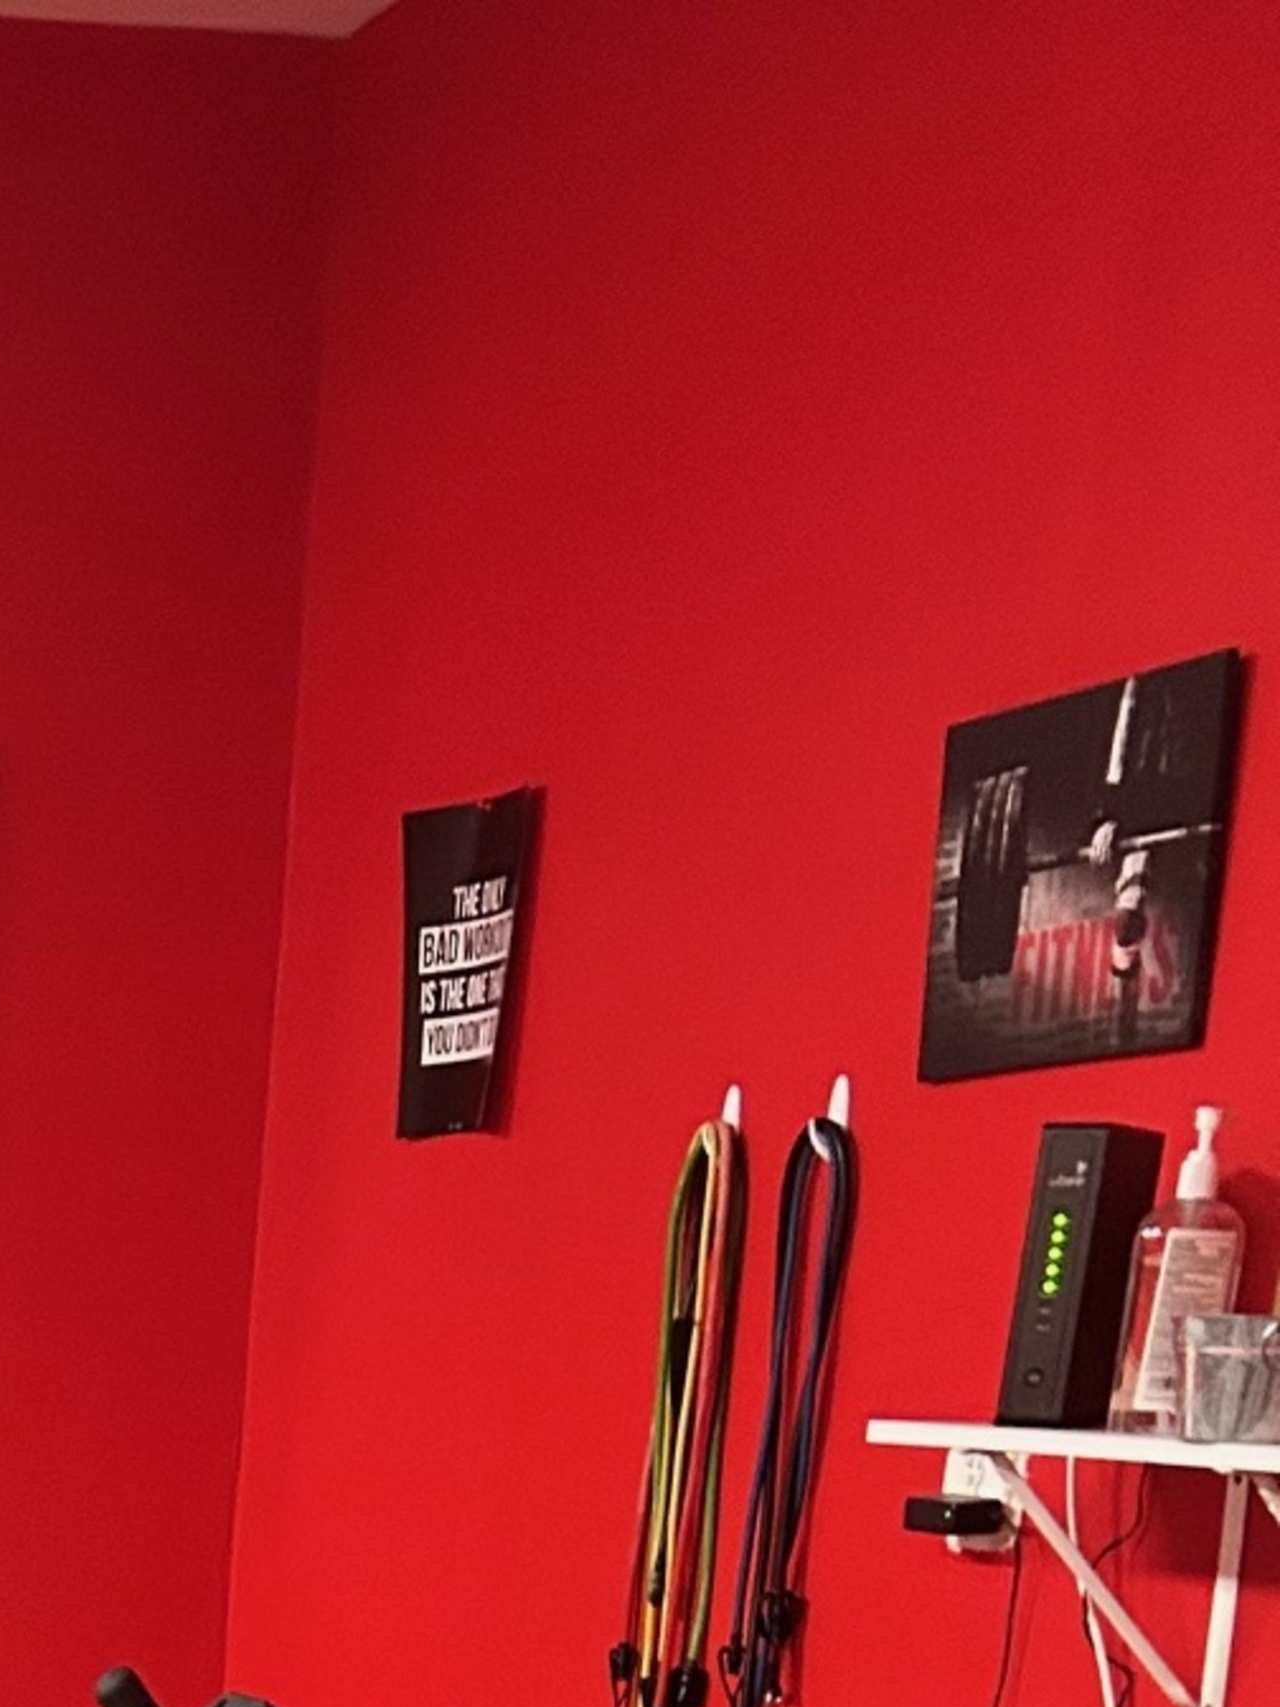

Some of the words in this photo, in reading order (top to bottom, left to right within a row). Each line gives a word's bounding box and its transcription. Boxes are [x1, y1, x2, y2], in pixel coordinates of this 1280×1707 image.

[453, 883, 481, 920] THE
[423, 929, 461, 968] BAD
[1009, 913, 1178, 1022] FITNES
[421, 980, 438, 1014] IS
[439, 976, 467, 1013] THE
[426, 1022, 455, 1057] YOU
